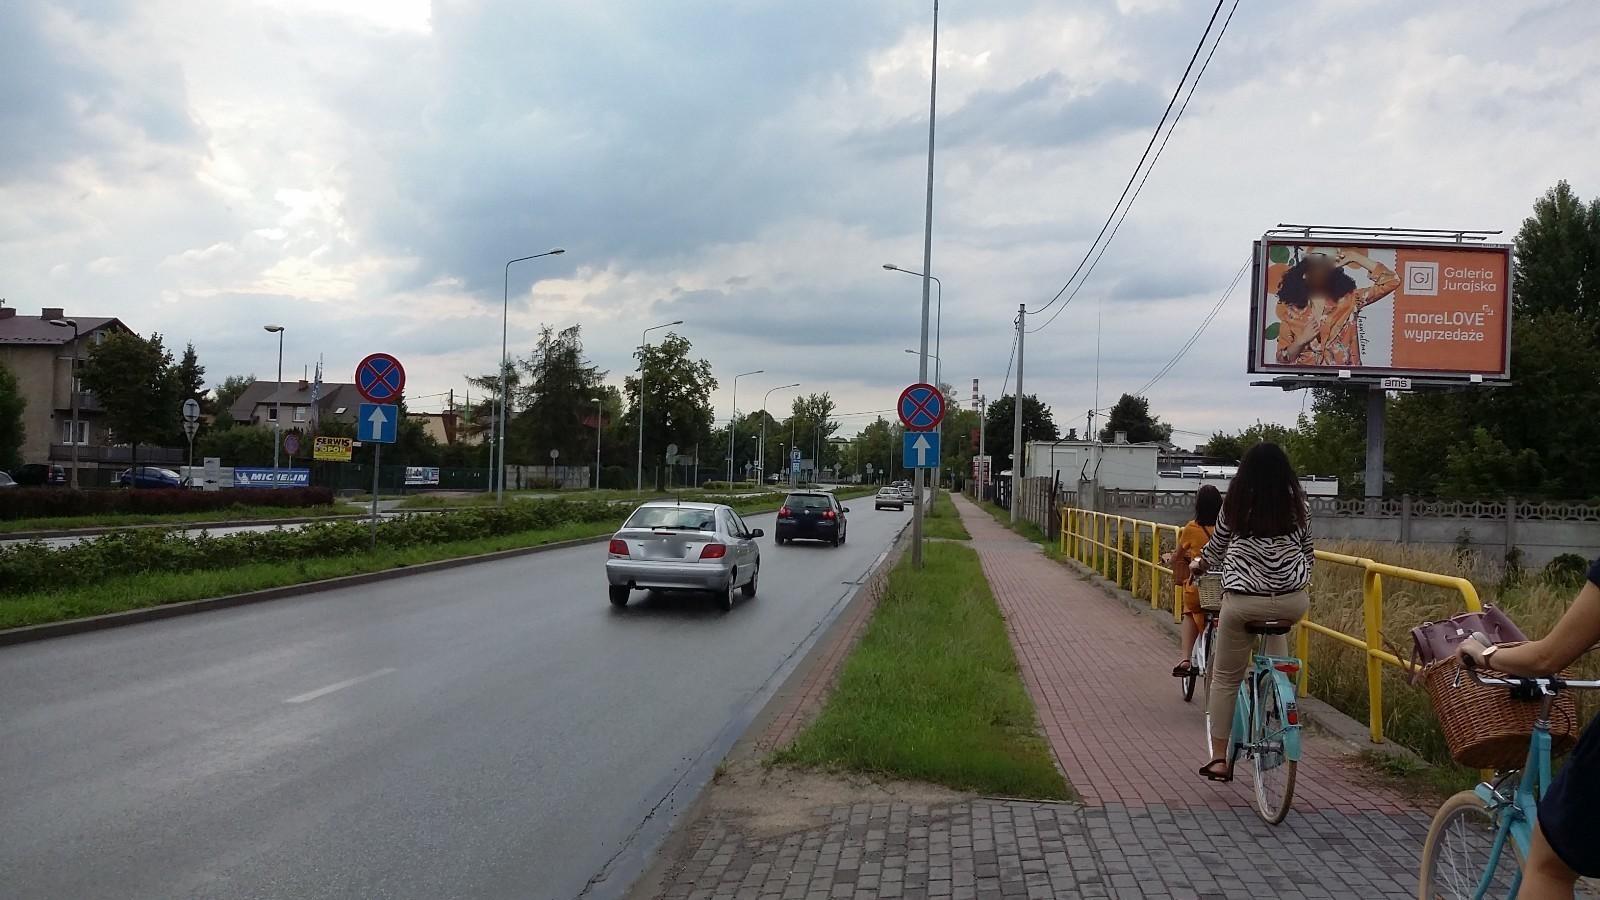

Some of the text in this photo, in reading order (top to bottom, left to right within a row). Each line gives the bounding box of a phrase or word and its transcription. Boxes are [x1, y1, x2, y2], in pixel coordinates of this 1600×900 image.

[1413, 272, 1430, 284] GJ
[1444, 267, 1493, 279] Galeria
[1443, 280, 1497, 292] Jurajska
[1404, 311, 1485, 326] moreLOVE
[1404, 328, 1485, 343] wyprzedaże
[1385, 379, 1407, 387] ams
[317, 437, 350, 446] SERWIS
